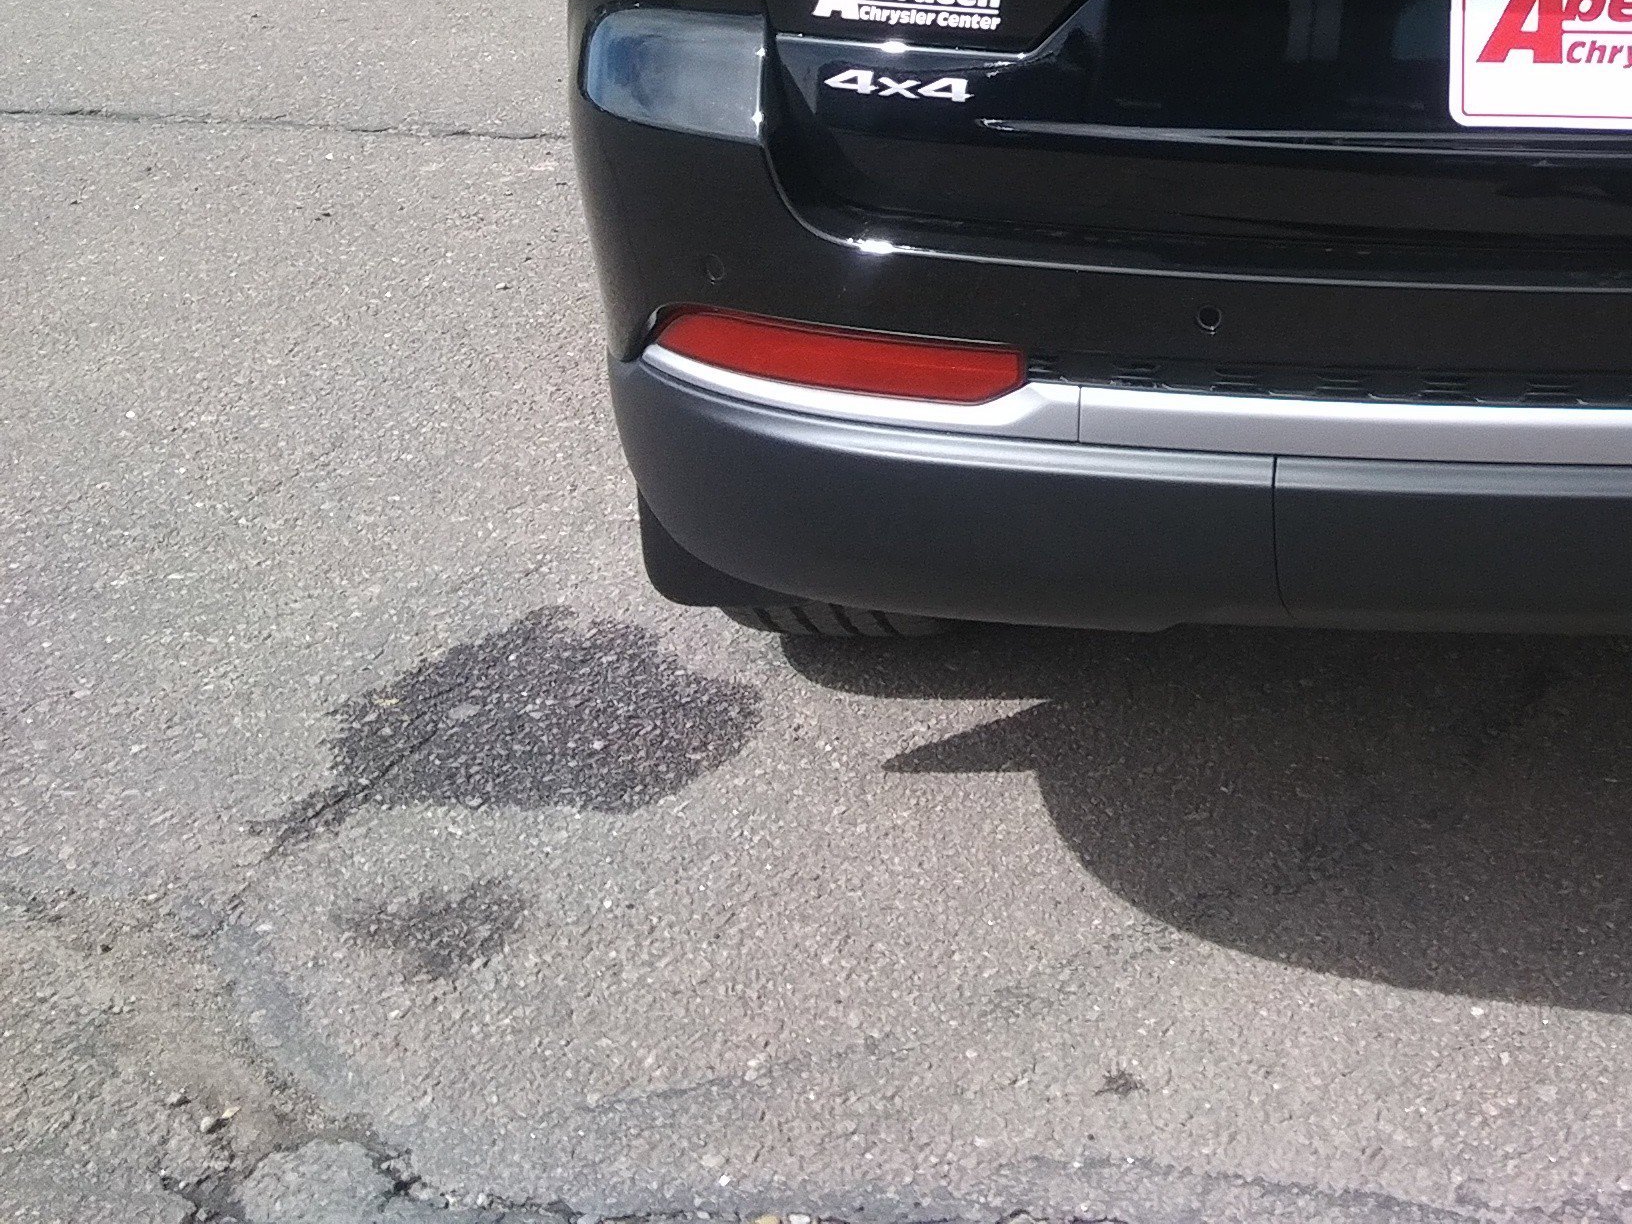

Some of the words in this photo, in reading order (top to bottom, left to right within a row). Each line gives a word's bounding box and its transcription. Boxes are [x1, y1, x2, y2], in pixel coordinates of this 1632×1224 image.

[859, 5, 936, 25] Chrysler
[937, 12, 1002, 31] Center
[823, 69, 975, 103] 4x4
